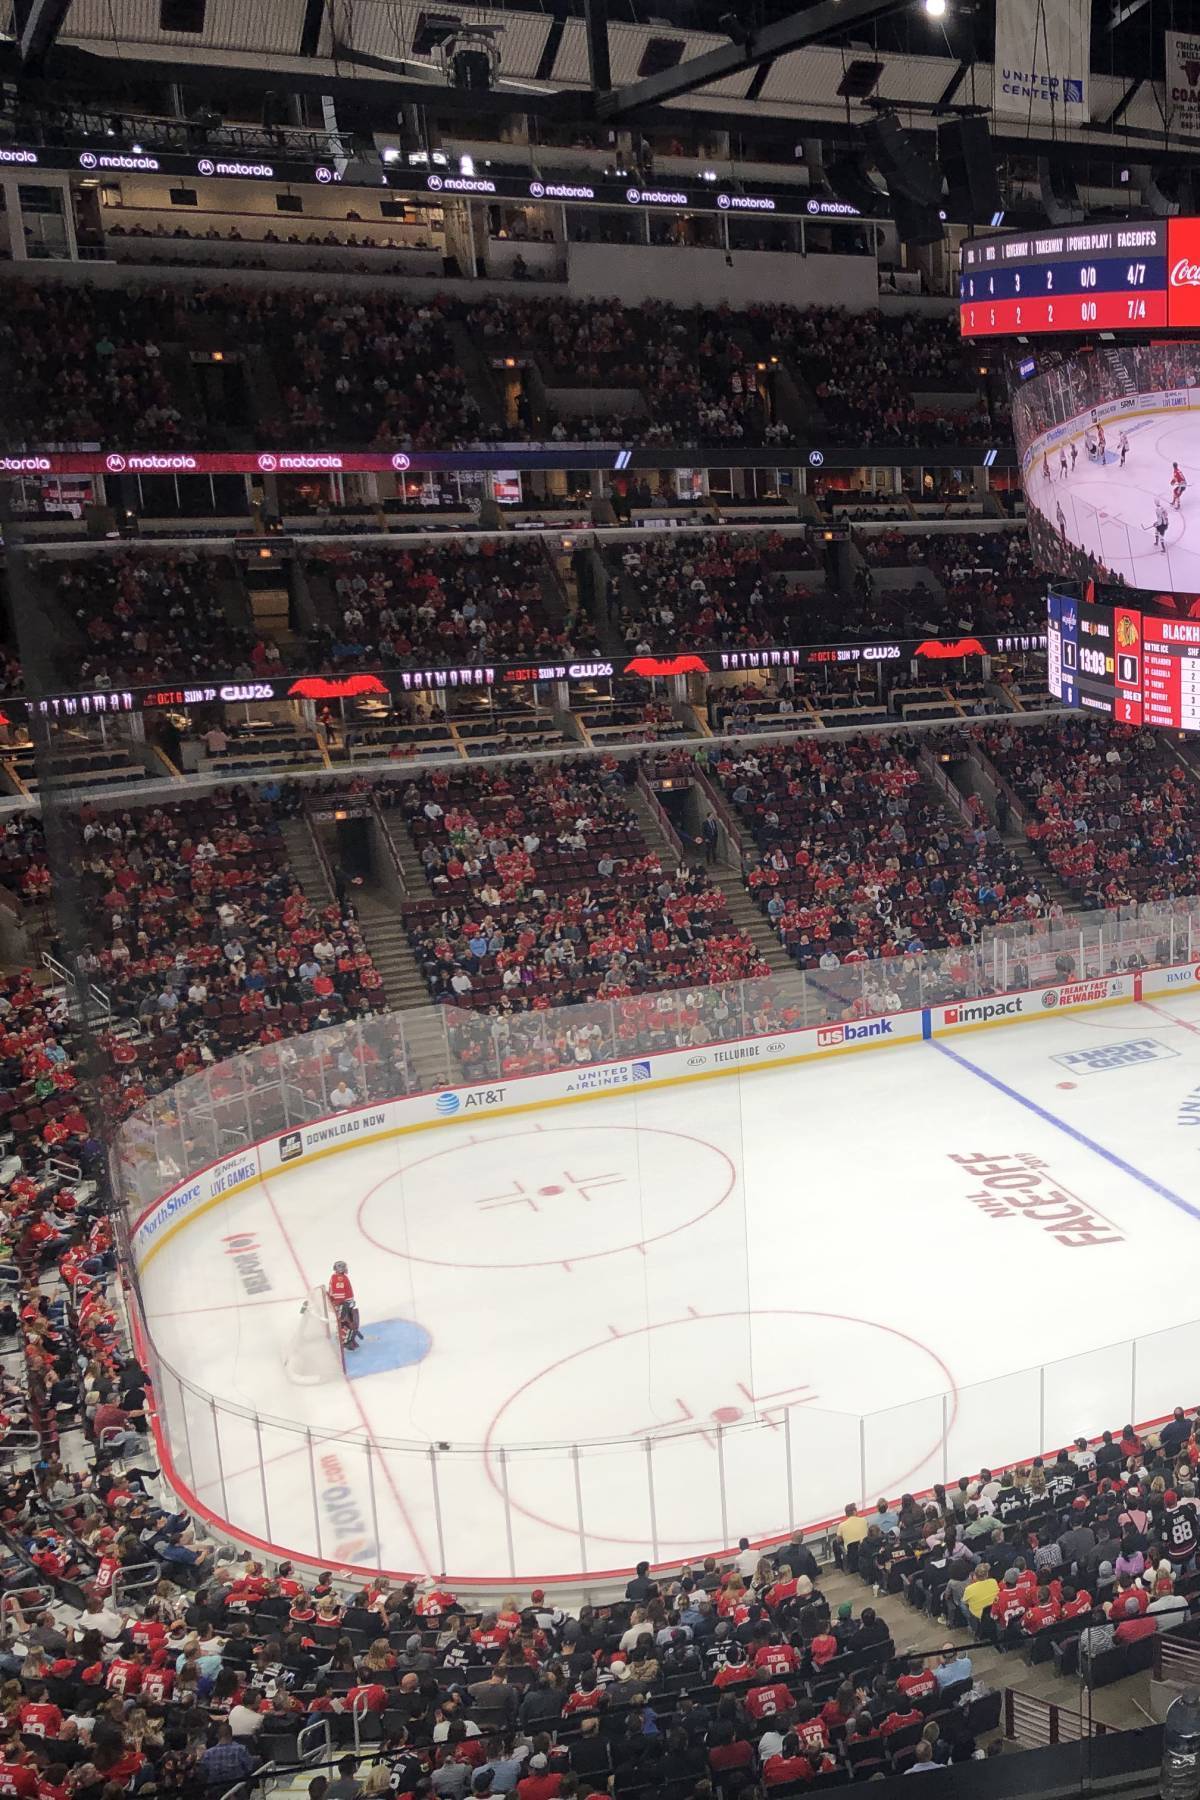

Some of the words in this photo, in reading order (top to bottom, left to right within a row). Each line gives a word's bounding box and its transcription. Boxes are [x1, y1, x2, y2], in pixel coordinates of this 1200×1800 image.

[1003, 69, 1060, 89] UNITED
[1002, 83, 1059, 102] CENTER
[100, 156, 159, 170] motorola
[216, 162, 274, 178] motorola
[444, 177, 496, 193] motorola
[545, 184, 594, 200] motorola
[641, 190, 688, 205] motorola
[730, 195, 776, 210] motorola
[1036, 237, 1063, 254] TAKEAWAY
[1117, 231, 1157, 248] FACEOFFS
[1127, 263, 1146, 286] 4/7
[1127, 300, 1146, 320] 7/4
[128, 455, 197, 470] motorola
[279, 455, 343, 469] motorola
[721, 650, 800, 671] BATWOMAN
[837, 649, 850, 661] SUN
[1080, 647, 1106, 676] 13:03
[401, 668, 494, 690] BATWOMAN
[538, 667, 554, 680] SUN
[184, 689, 203, 703] SUN
[1167, 971, 1192, 983] BMO
[1060, 984, 1083, 995] FREAKY
[1084, 980, 1109, 992] FAST
[1059, 989, 1109, 1006] REWARDS
[958, 997, 1023, 1023] impact
[714, 1046, 760, 1064] TELLURIDE
[1063, 1040, 1157, 1064] LIGHT
[1088, 1051, 1157, 1069] BUD
[578, 1066, 628, 1082] UNITED
[566, 1075, 629, 1092] AIRLINES
[465, 1088, 507, 1108] AT&T
[306, 1121, 360, 1146] DOWNLOAD
[362, 1113, 386, 1130] NOW
[210, 1178, 227, 1198] LIVE
[227, 1163, 256, 1191] GAMES
[946, 1152, 1126, 1248] FACE-OFF
[965, 1190, 1017, 1218] NHL
[1171, 1523, 1193, 1545] 88
